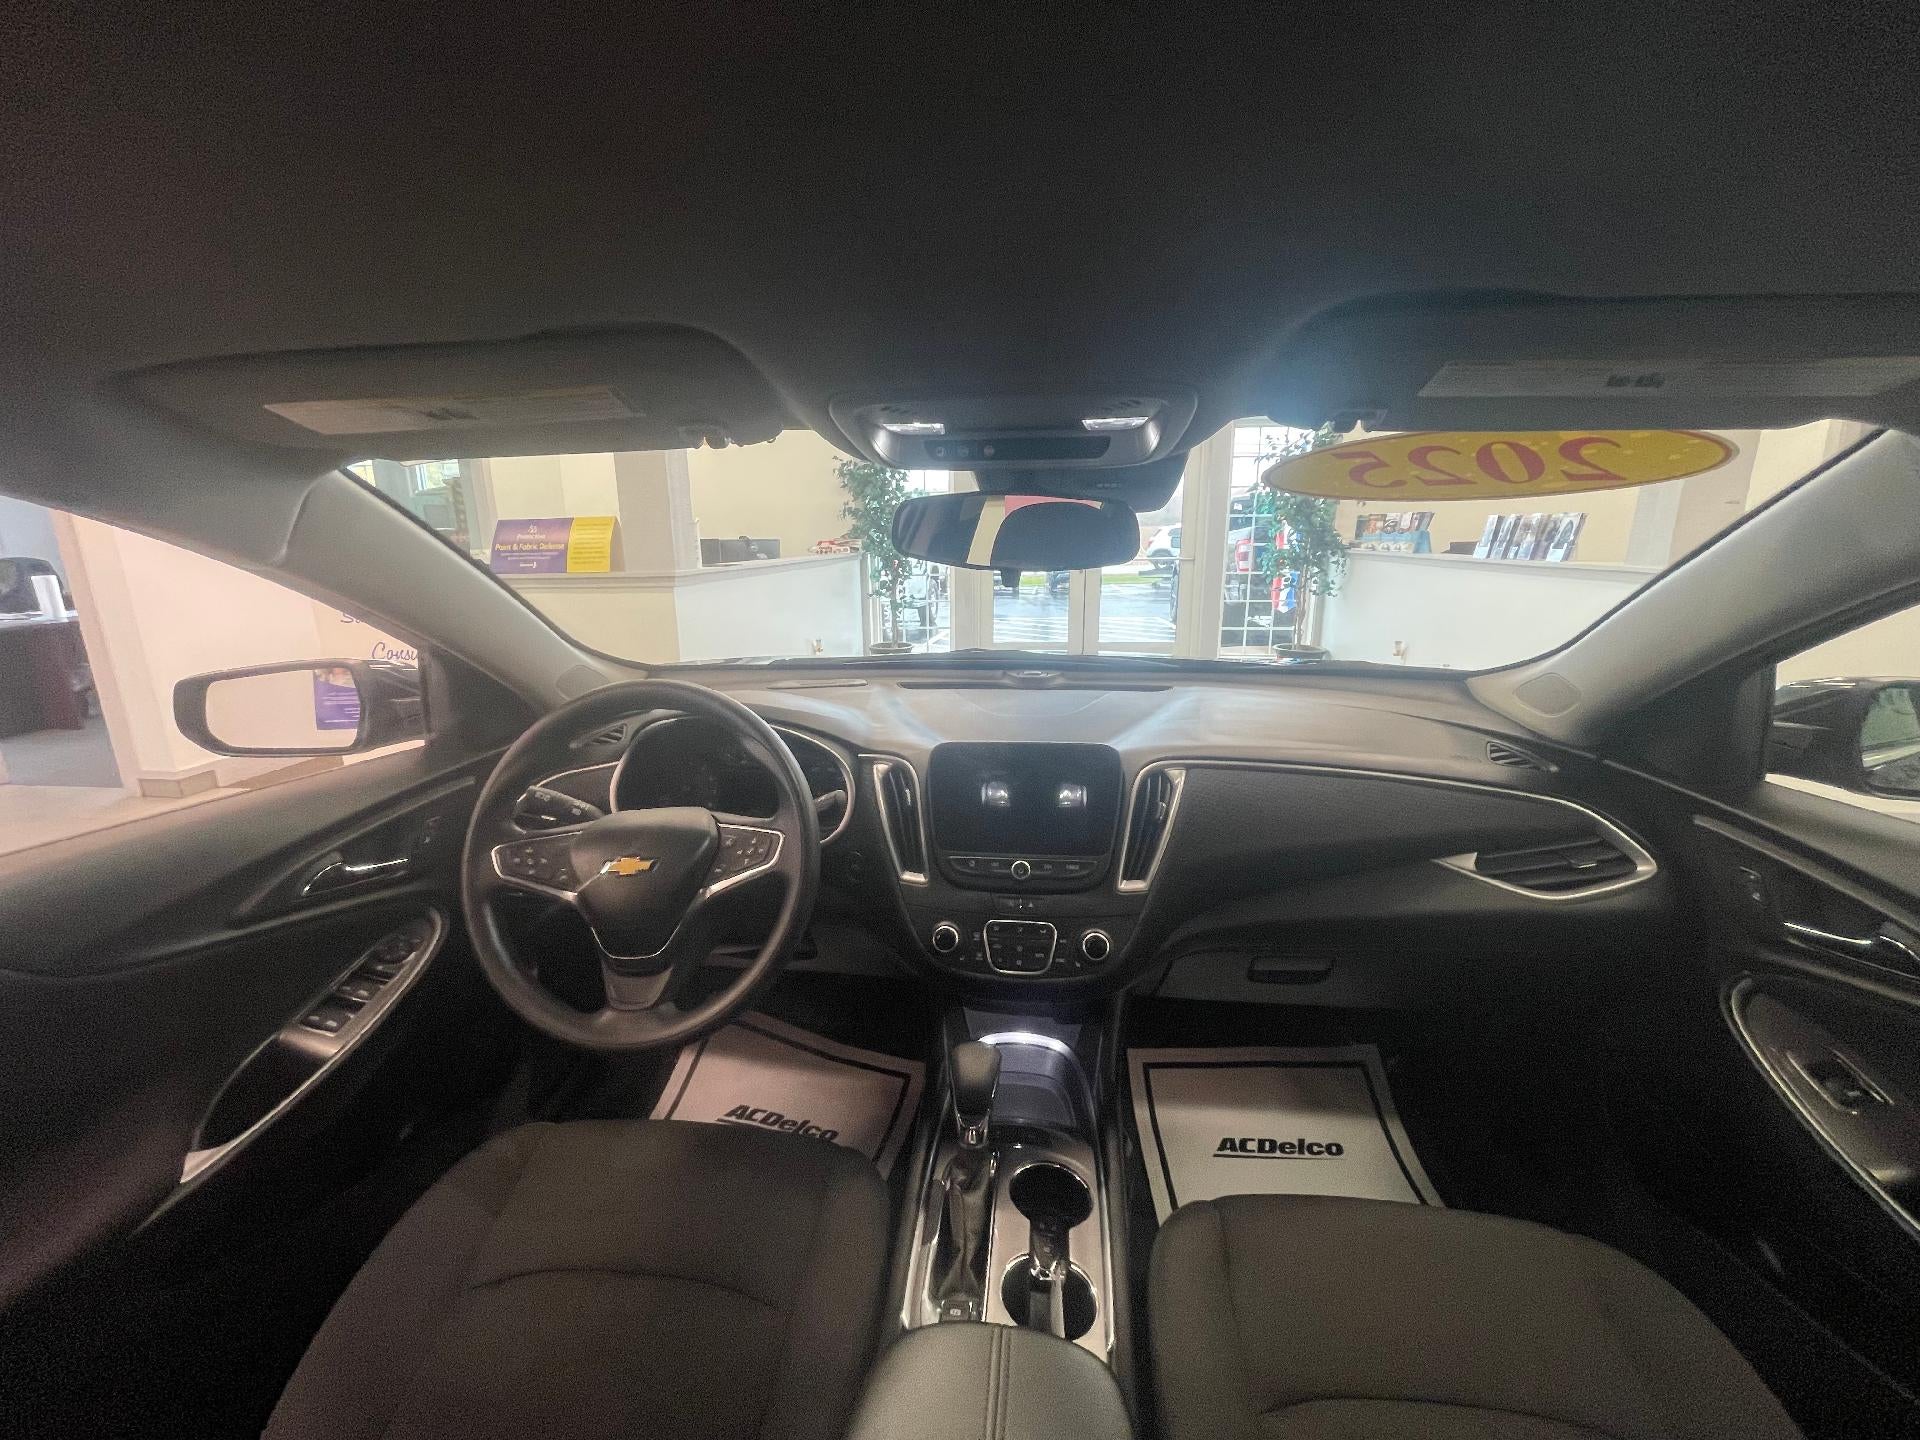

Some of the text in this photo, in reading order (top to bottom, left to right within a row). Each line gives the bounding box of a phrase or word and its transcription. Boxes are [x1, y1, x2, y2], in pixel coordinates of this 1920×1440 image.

[519, 543, 538, 551] Fabric
[723, 1104, 839, 1141] ACDelco
[1215, 1137, 1345, 1156] ACDelco
